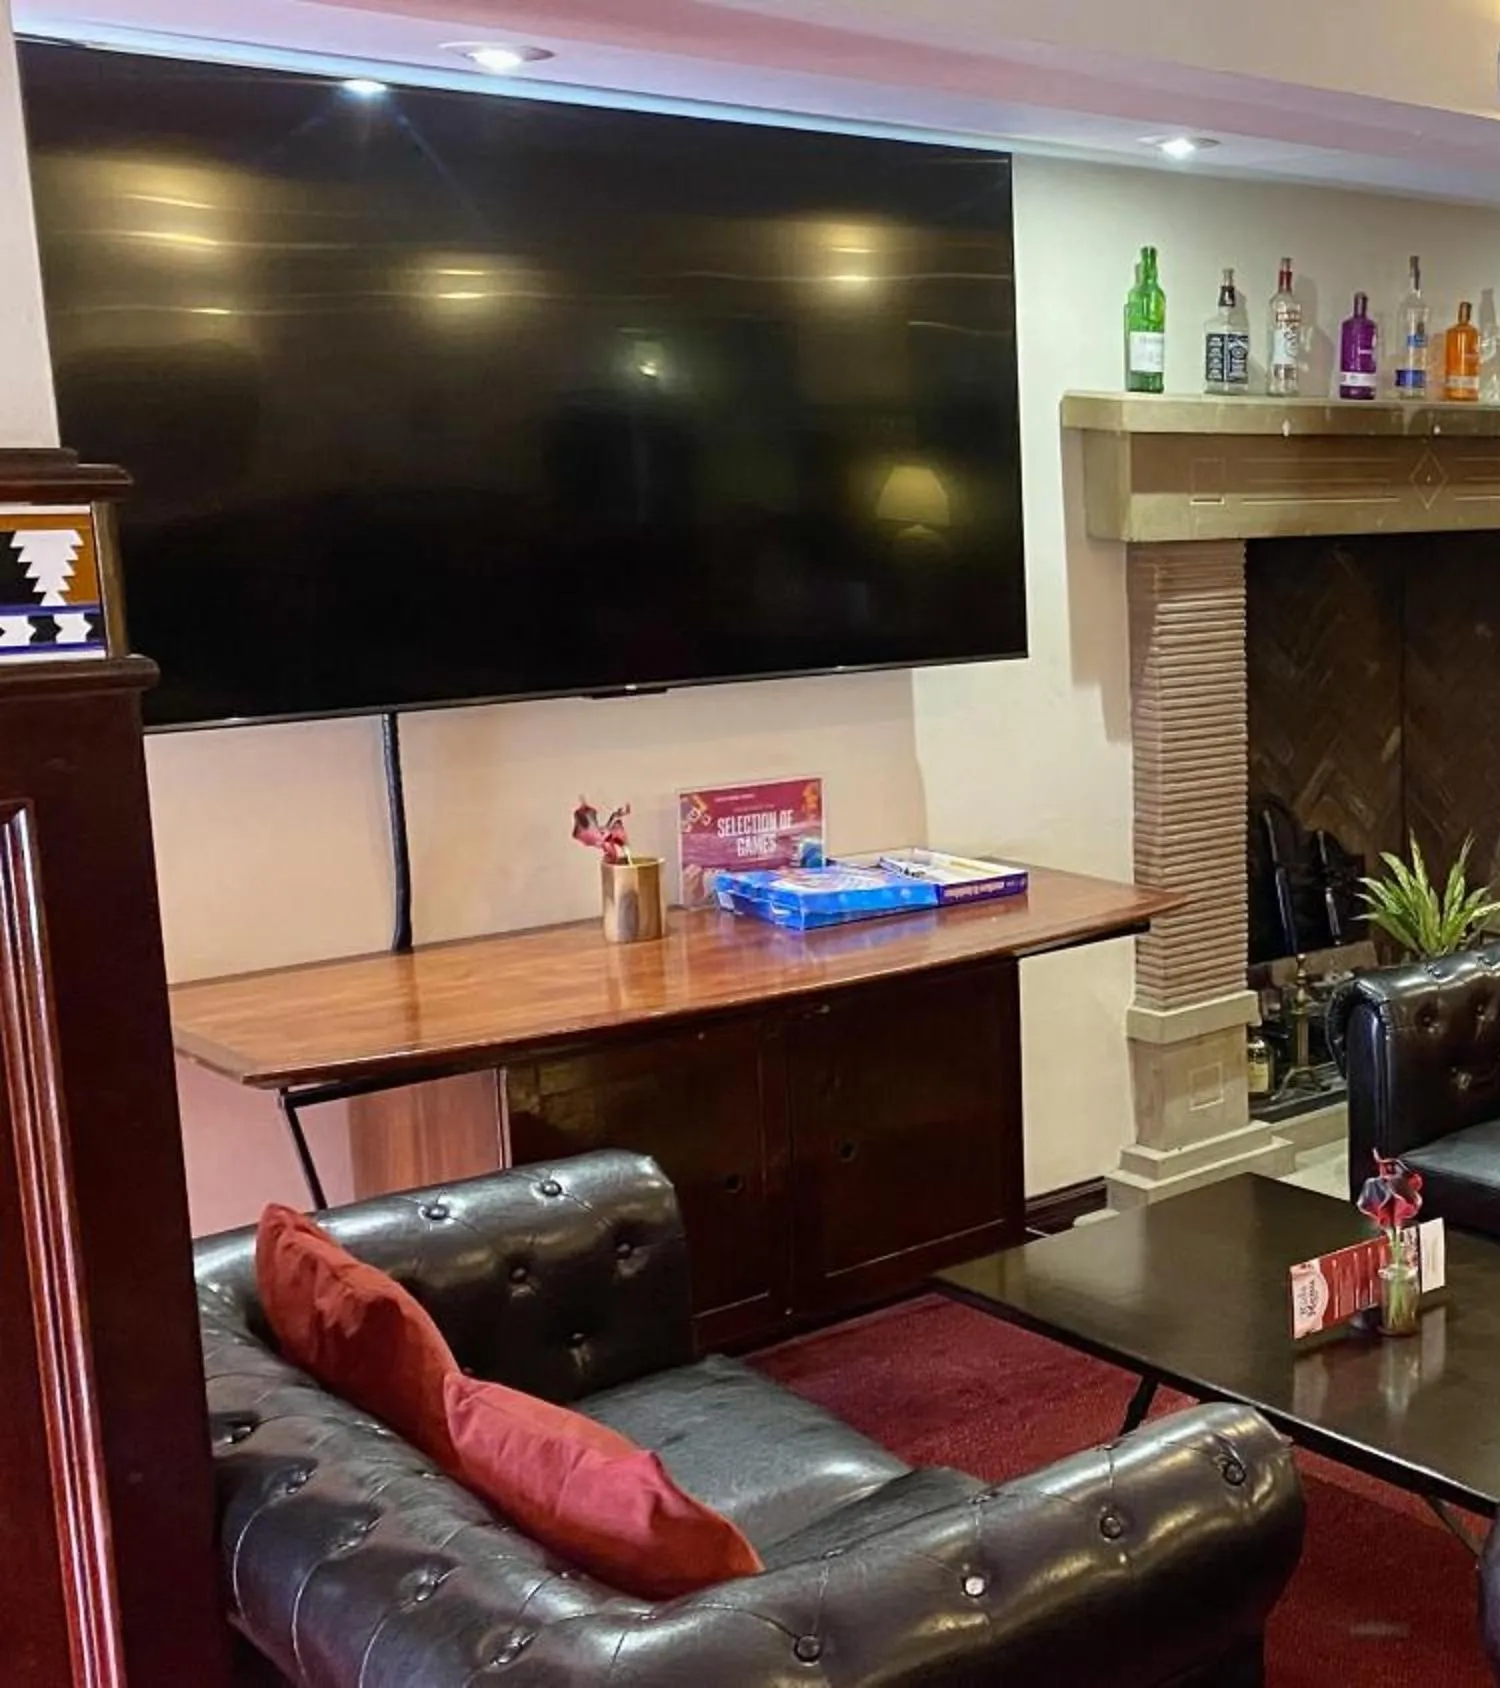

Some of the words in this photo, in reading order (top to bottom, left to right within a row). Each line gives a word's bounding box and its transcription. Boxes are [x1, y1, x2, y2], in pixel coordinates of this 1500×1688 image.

[717, 810, 777, 838] SELECTION
[779, 809, 794, 830] OF
[737, 833, 777, 856] GAMES
